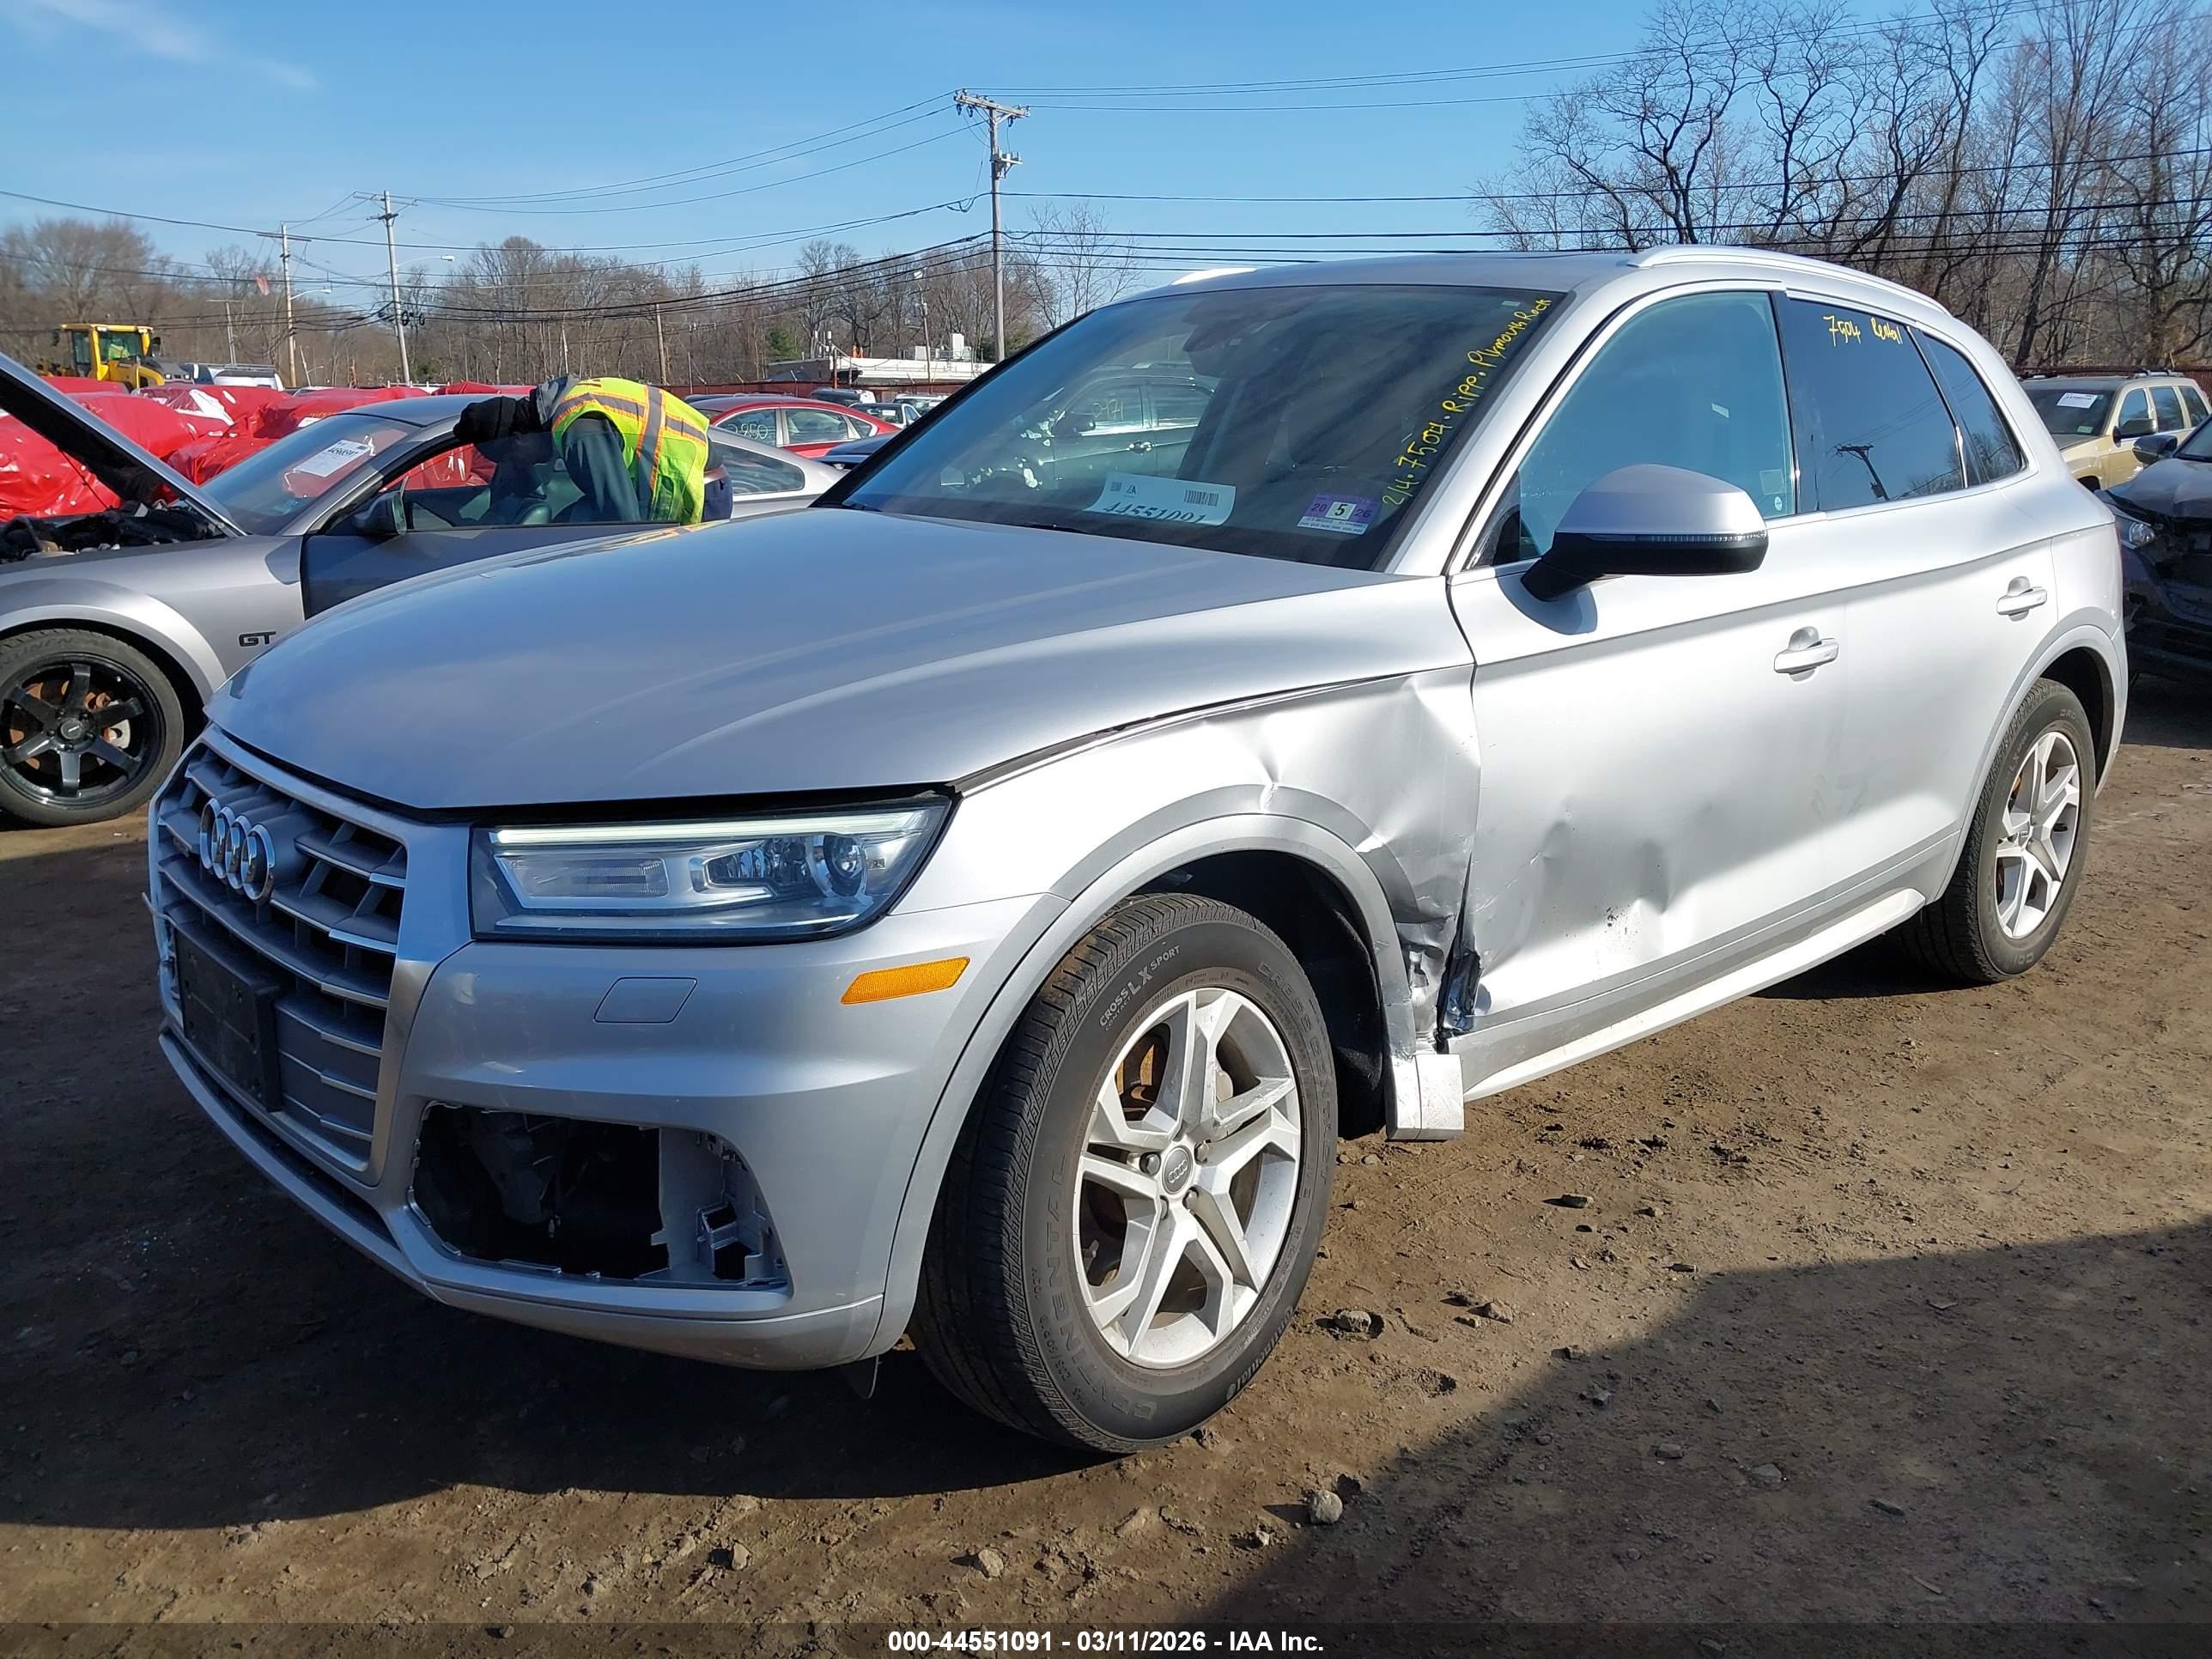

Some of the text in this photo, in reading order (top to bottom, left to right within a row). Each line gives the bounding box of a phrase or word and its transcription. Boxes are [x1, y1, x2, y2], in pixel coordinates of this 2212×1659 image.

[1822, 315, 1861, 348] 7504
[1312, 503, 1371, 518] 20 5 26
[239, 631, 276, 647] GT
[1099, 988, 1129, 1027] CROSS
[1150, 945, 1181, 971] SPORT
[1105, 995, 1133, 1031] CONTACT
